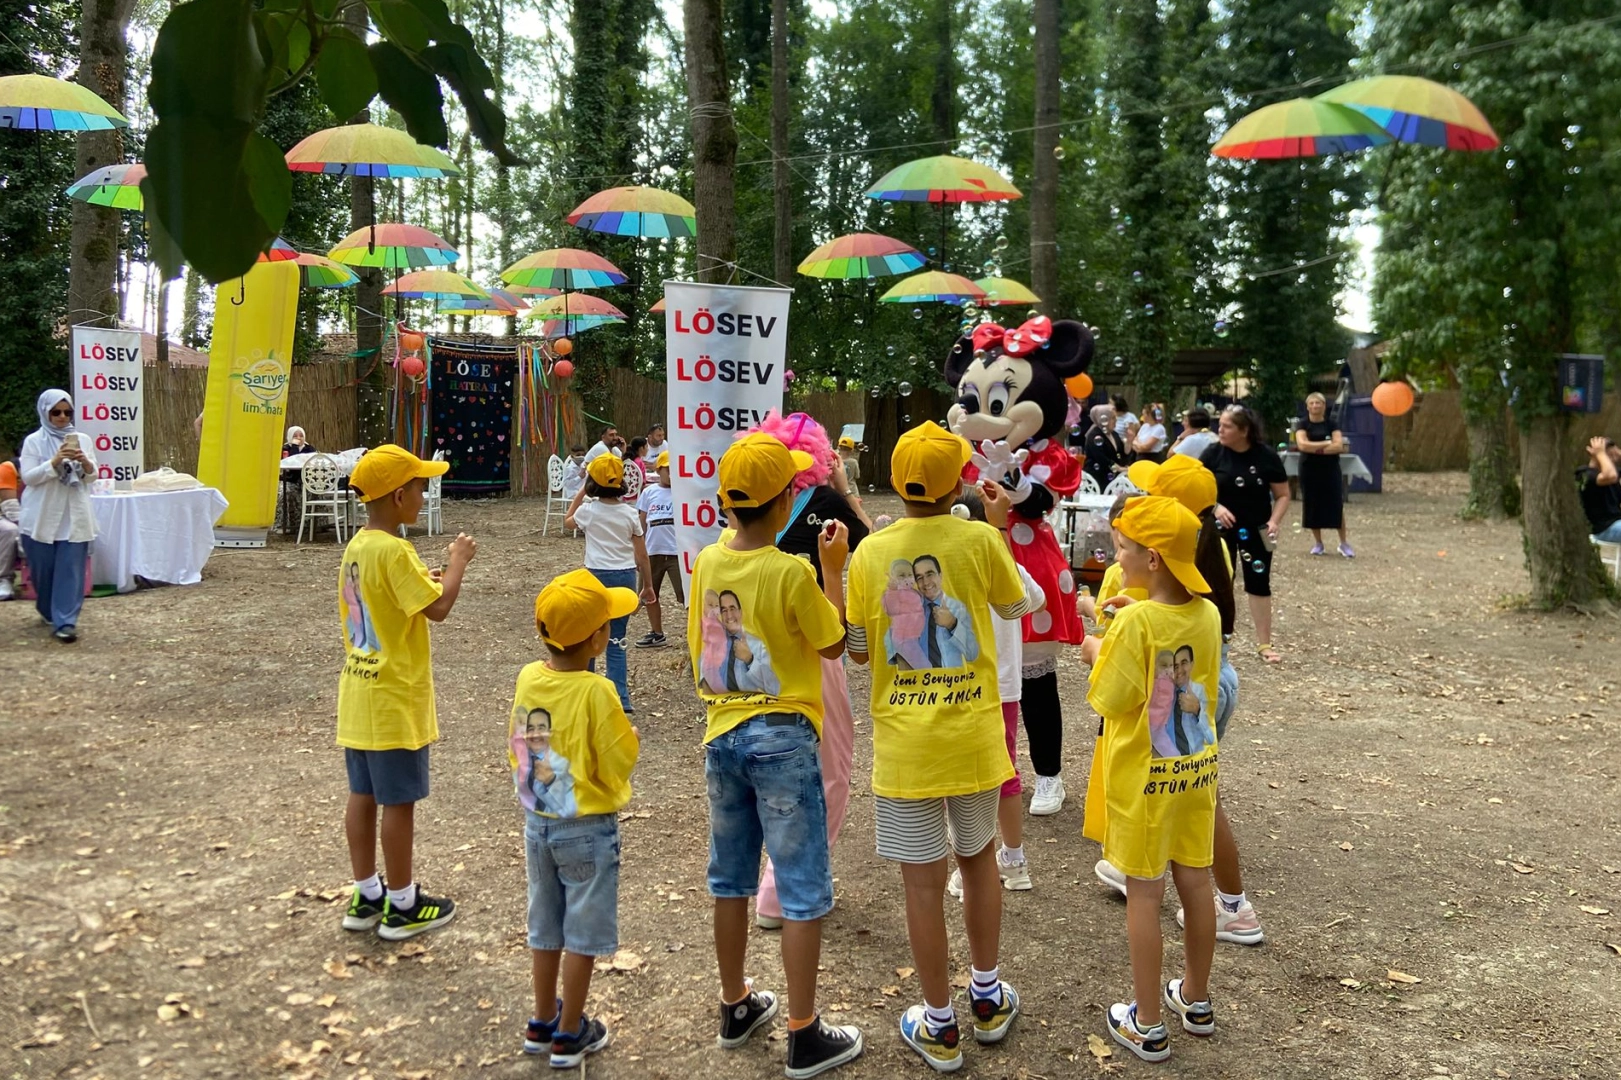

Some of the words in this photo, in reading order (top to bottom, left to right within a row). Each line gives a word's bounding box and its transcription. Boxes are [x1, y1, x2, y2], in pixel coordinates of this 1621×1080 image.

[675, 308, 777, 338] LÖSEV
[81, 343, 139, 362] LÖSEV
[677, 355, 774, 385] LÖSEV
[82, 372, 139, 391] LÖSEV
[82, 403, 139, 421] LÖSEV
[678, 402, 770, 431] LÖSEV
[95, 433, 139, 451] ÖSEV
[98, 464, 139, 481] ÖSEV
[889, 690, 938, 706] ÜSTÜN
[1150, 763, 1168, 774] eni
[1172, 754, 1218, 774] Seviyoruz
